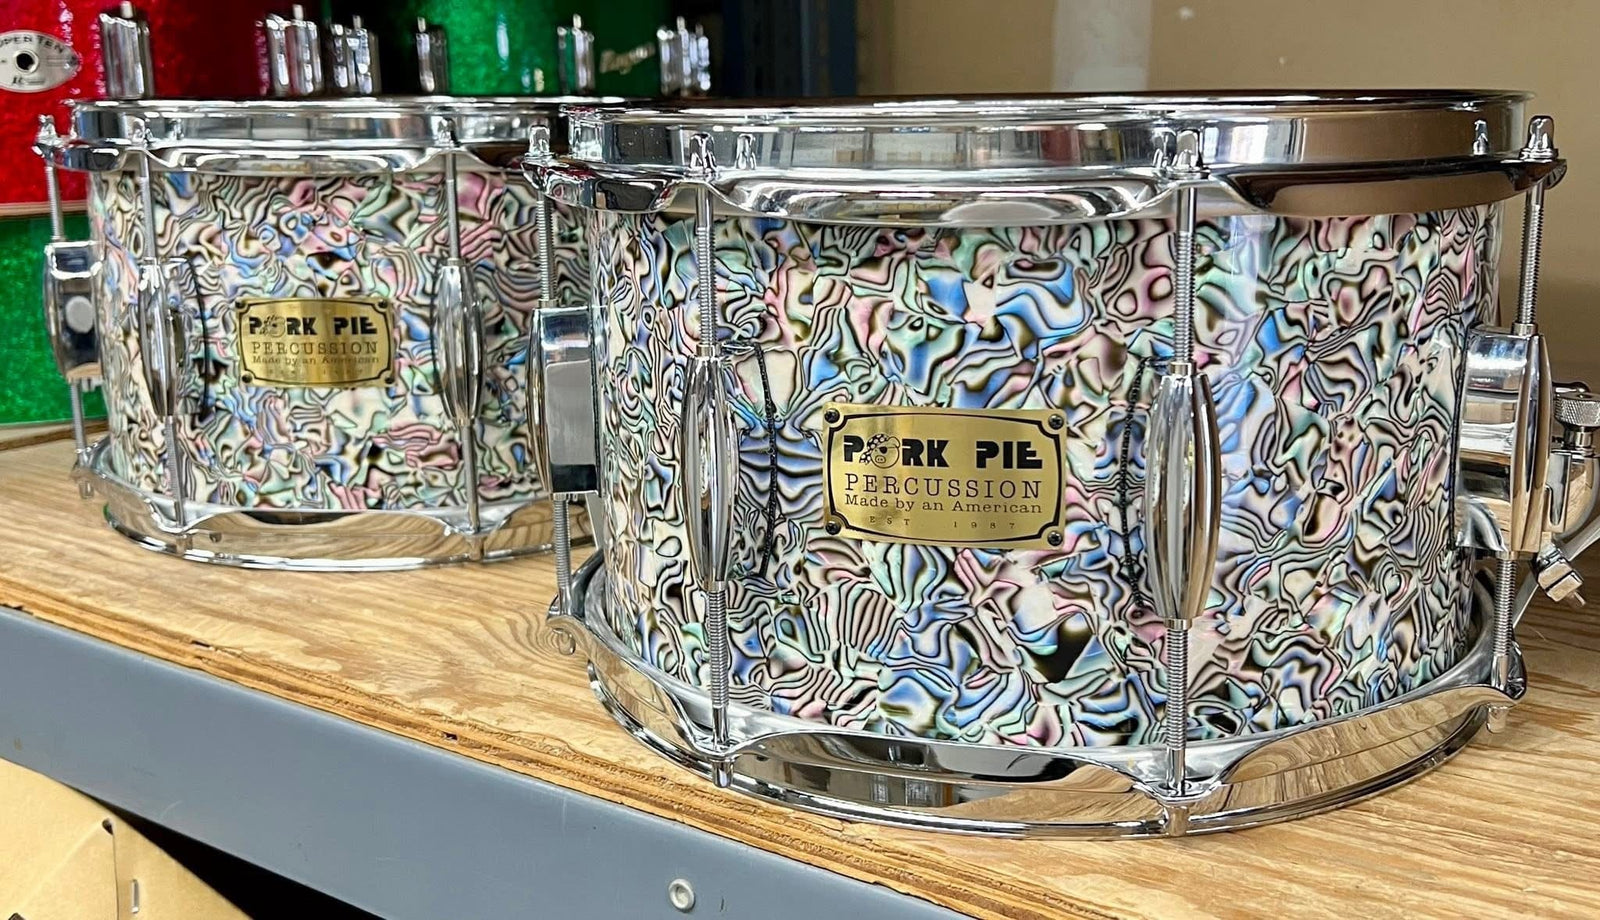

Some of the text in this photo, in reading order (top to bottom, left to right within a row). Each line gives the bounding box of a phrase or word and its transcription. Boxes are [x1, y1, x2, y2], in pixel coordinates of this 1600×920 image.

[249, 314, 377, 338] PORK PIE
[251, 341, 378, 355] PERCUSSION
[252, 355, 282, 364] Made
[285, 355, 298, 366] by
[843, 434, 1043, 469] PORK PIE
[844, 473, 1042, 499] PERCUSSION
[845, 493, 1042, 513] Made by an American
[869, 515, 1016, 530] EST 1987
